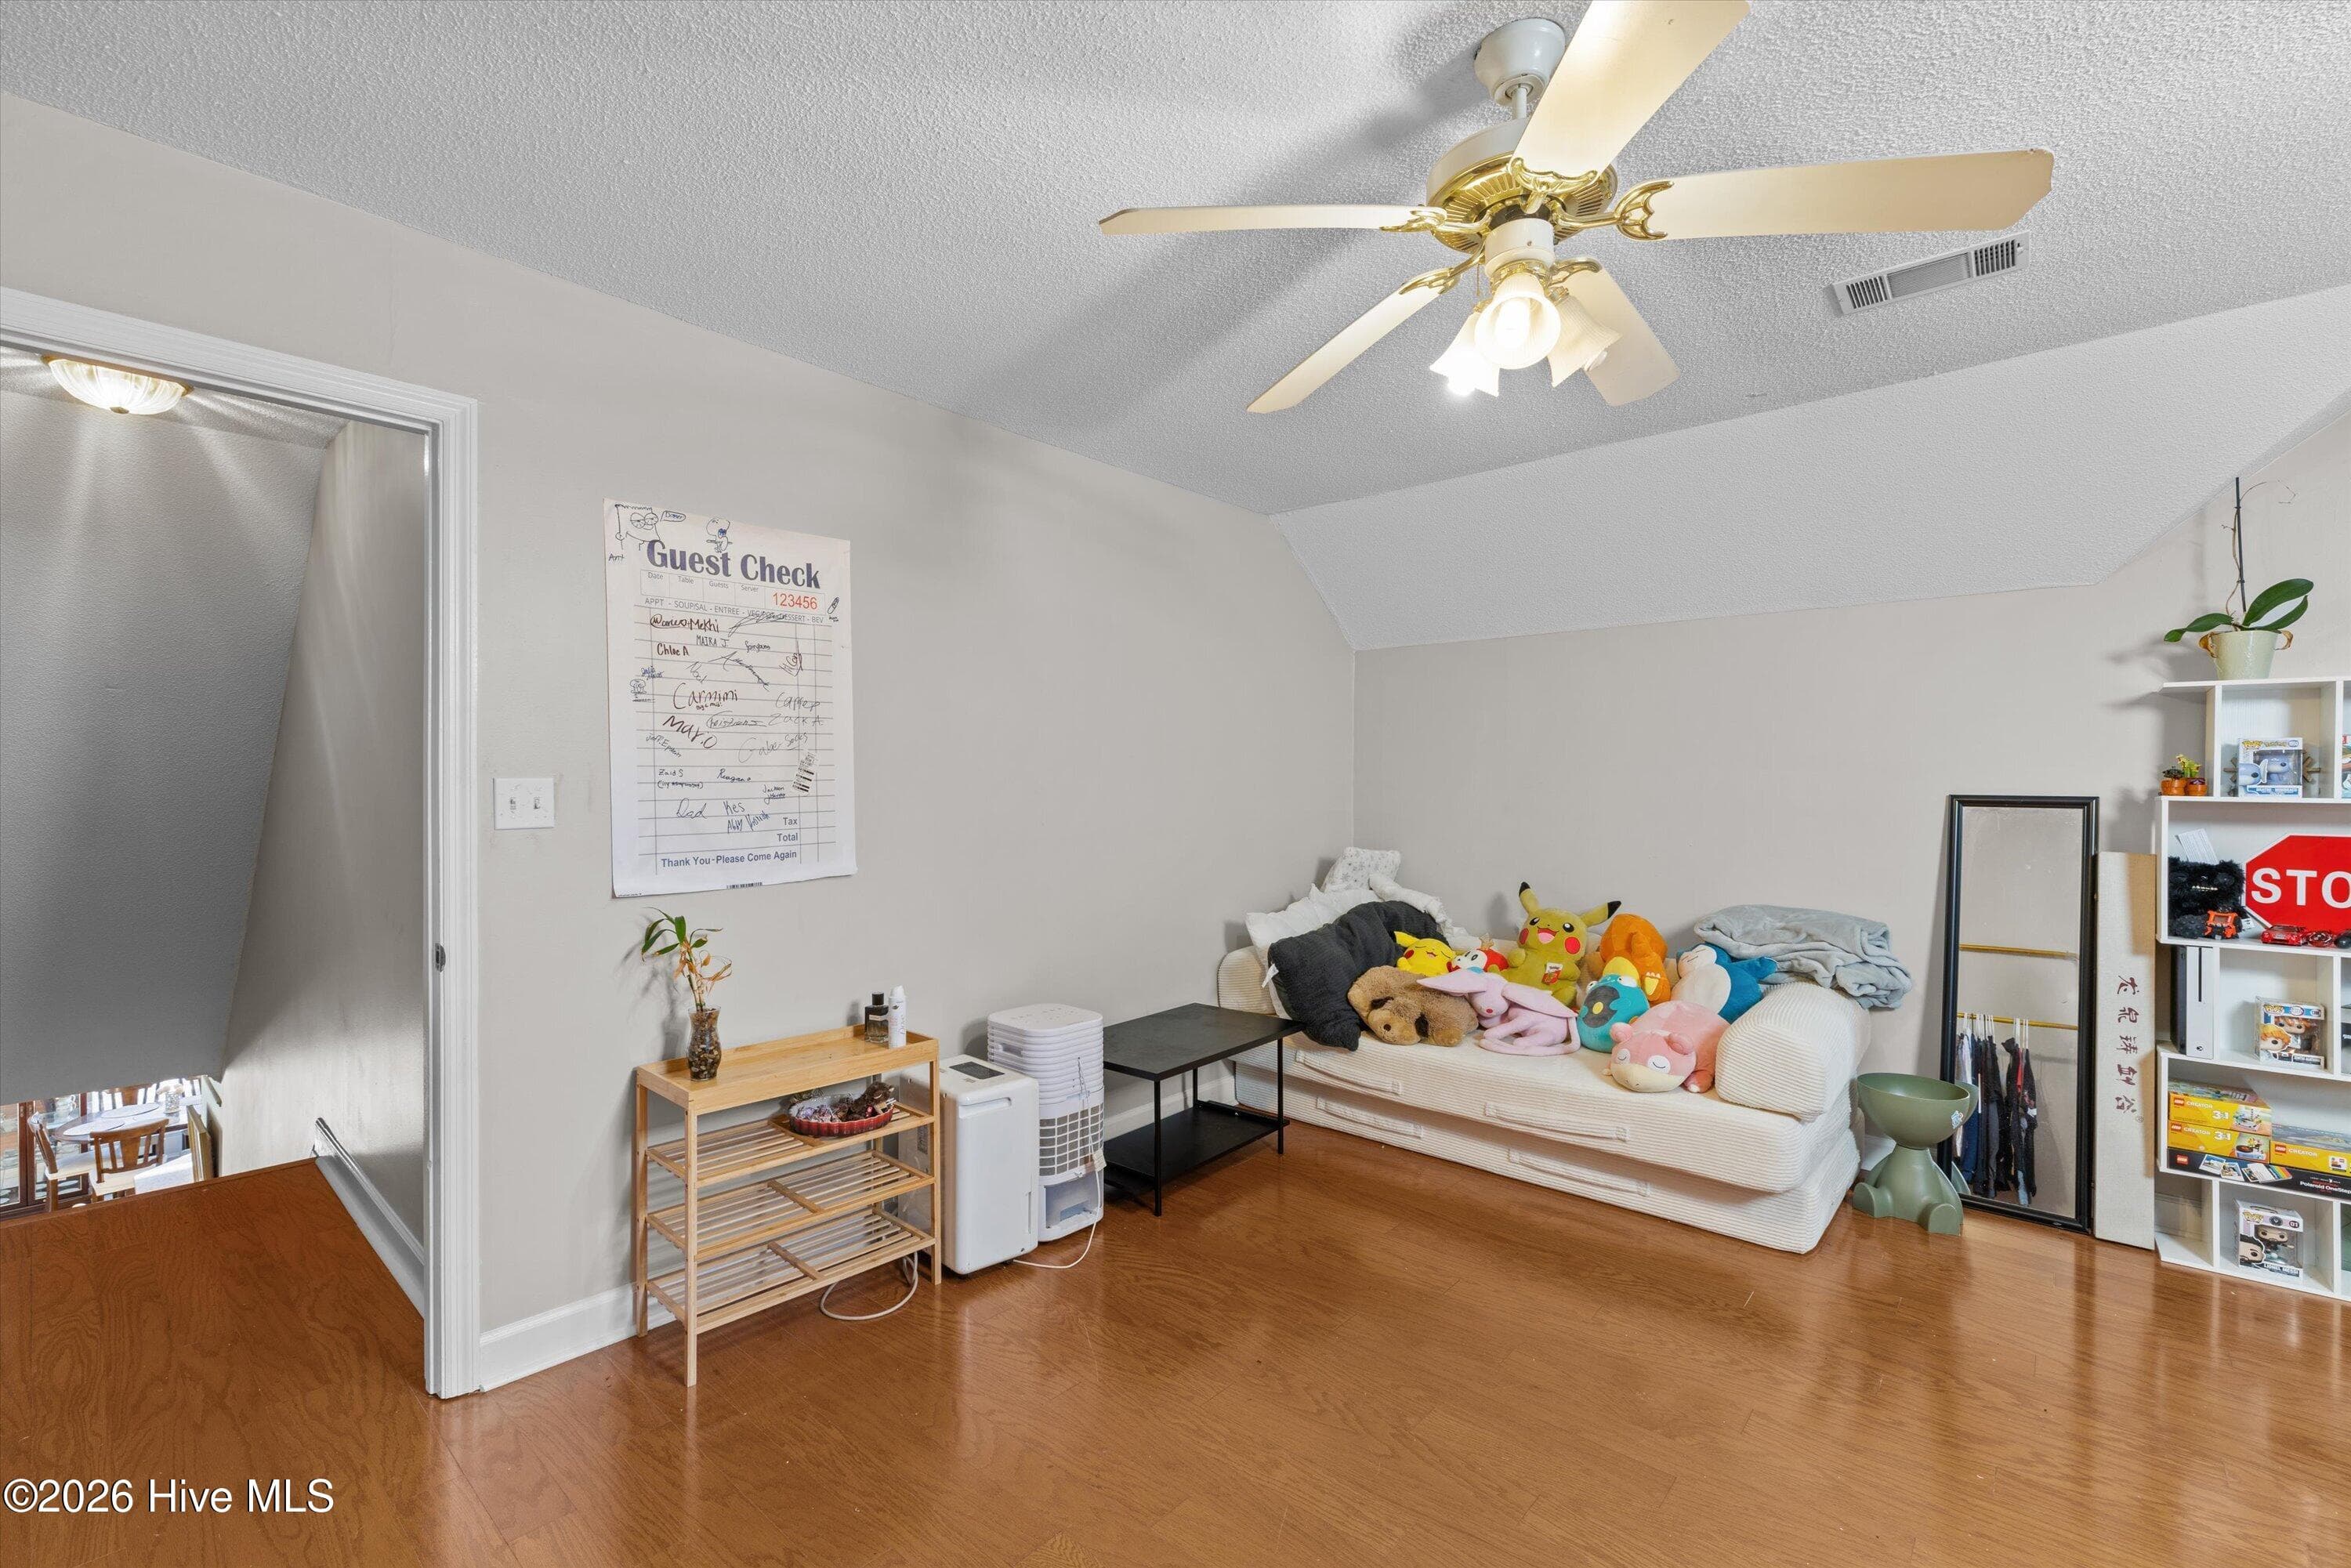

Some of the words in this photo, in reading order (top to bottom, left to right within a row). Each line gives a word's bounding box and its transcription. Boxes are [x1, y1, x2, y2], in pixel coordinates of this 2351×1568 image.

[647, 539, 731, 578] Guest
[741, 553, 820, 589] Check
[678, 575, 694, 584] Table
[708, 580, 729, 588] Guests
[741, 584, 759, 592] Server
[773, 592, 817, 610] 123456
[645, 597, 664, 607] APPT
[714, 606, 740, 615] ENTREE
[657, 643, 680, 656] Chloe
[683, 646, 690, 656] A
[777, 833, 798, 842] Total
[661, 858, 690, 867] Thank
[747, 853, 771, 862] Come
[773, 850, 797, 861] Again
[2251, 867, 2351, 909] STO
[2183, 1127, 2211, 1135] CREATOR
[2288, 1148, 2317, 1157] CREATOR
[2299, 1181, 2324, 1190] Polaroid
